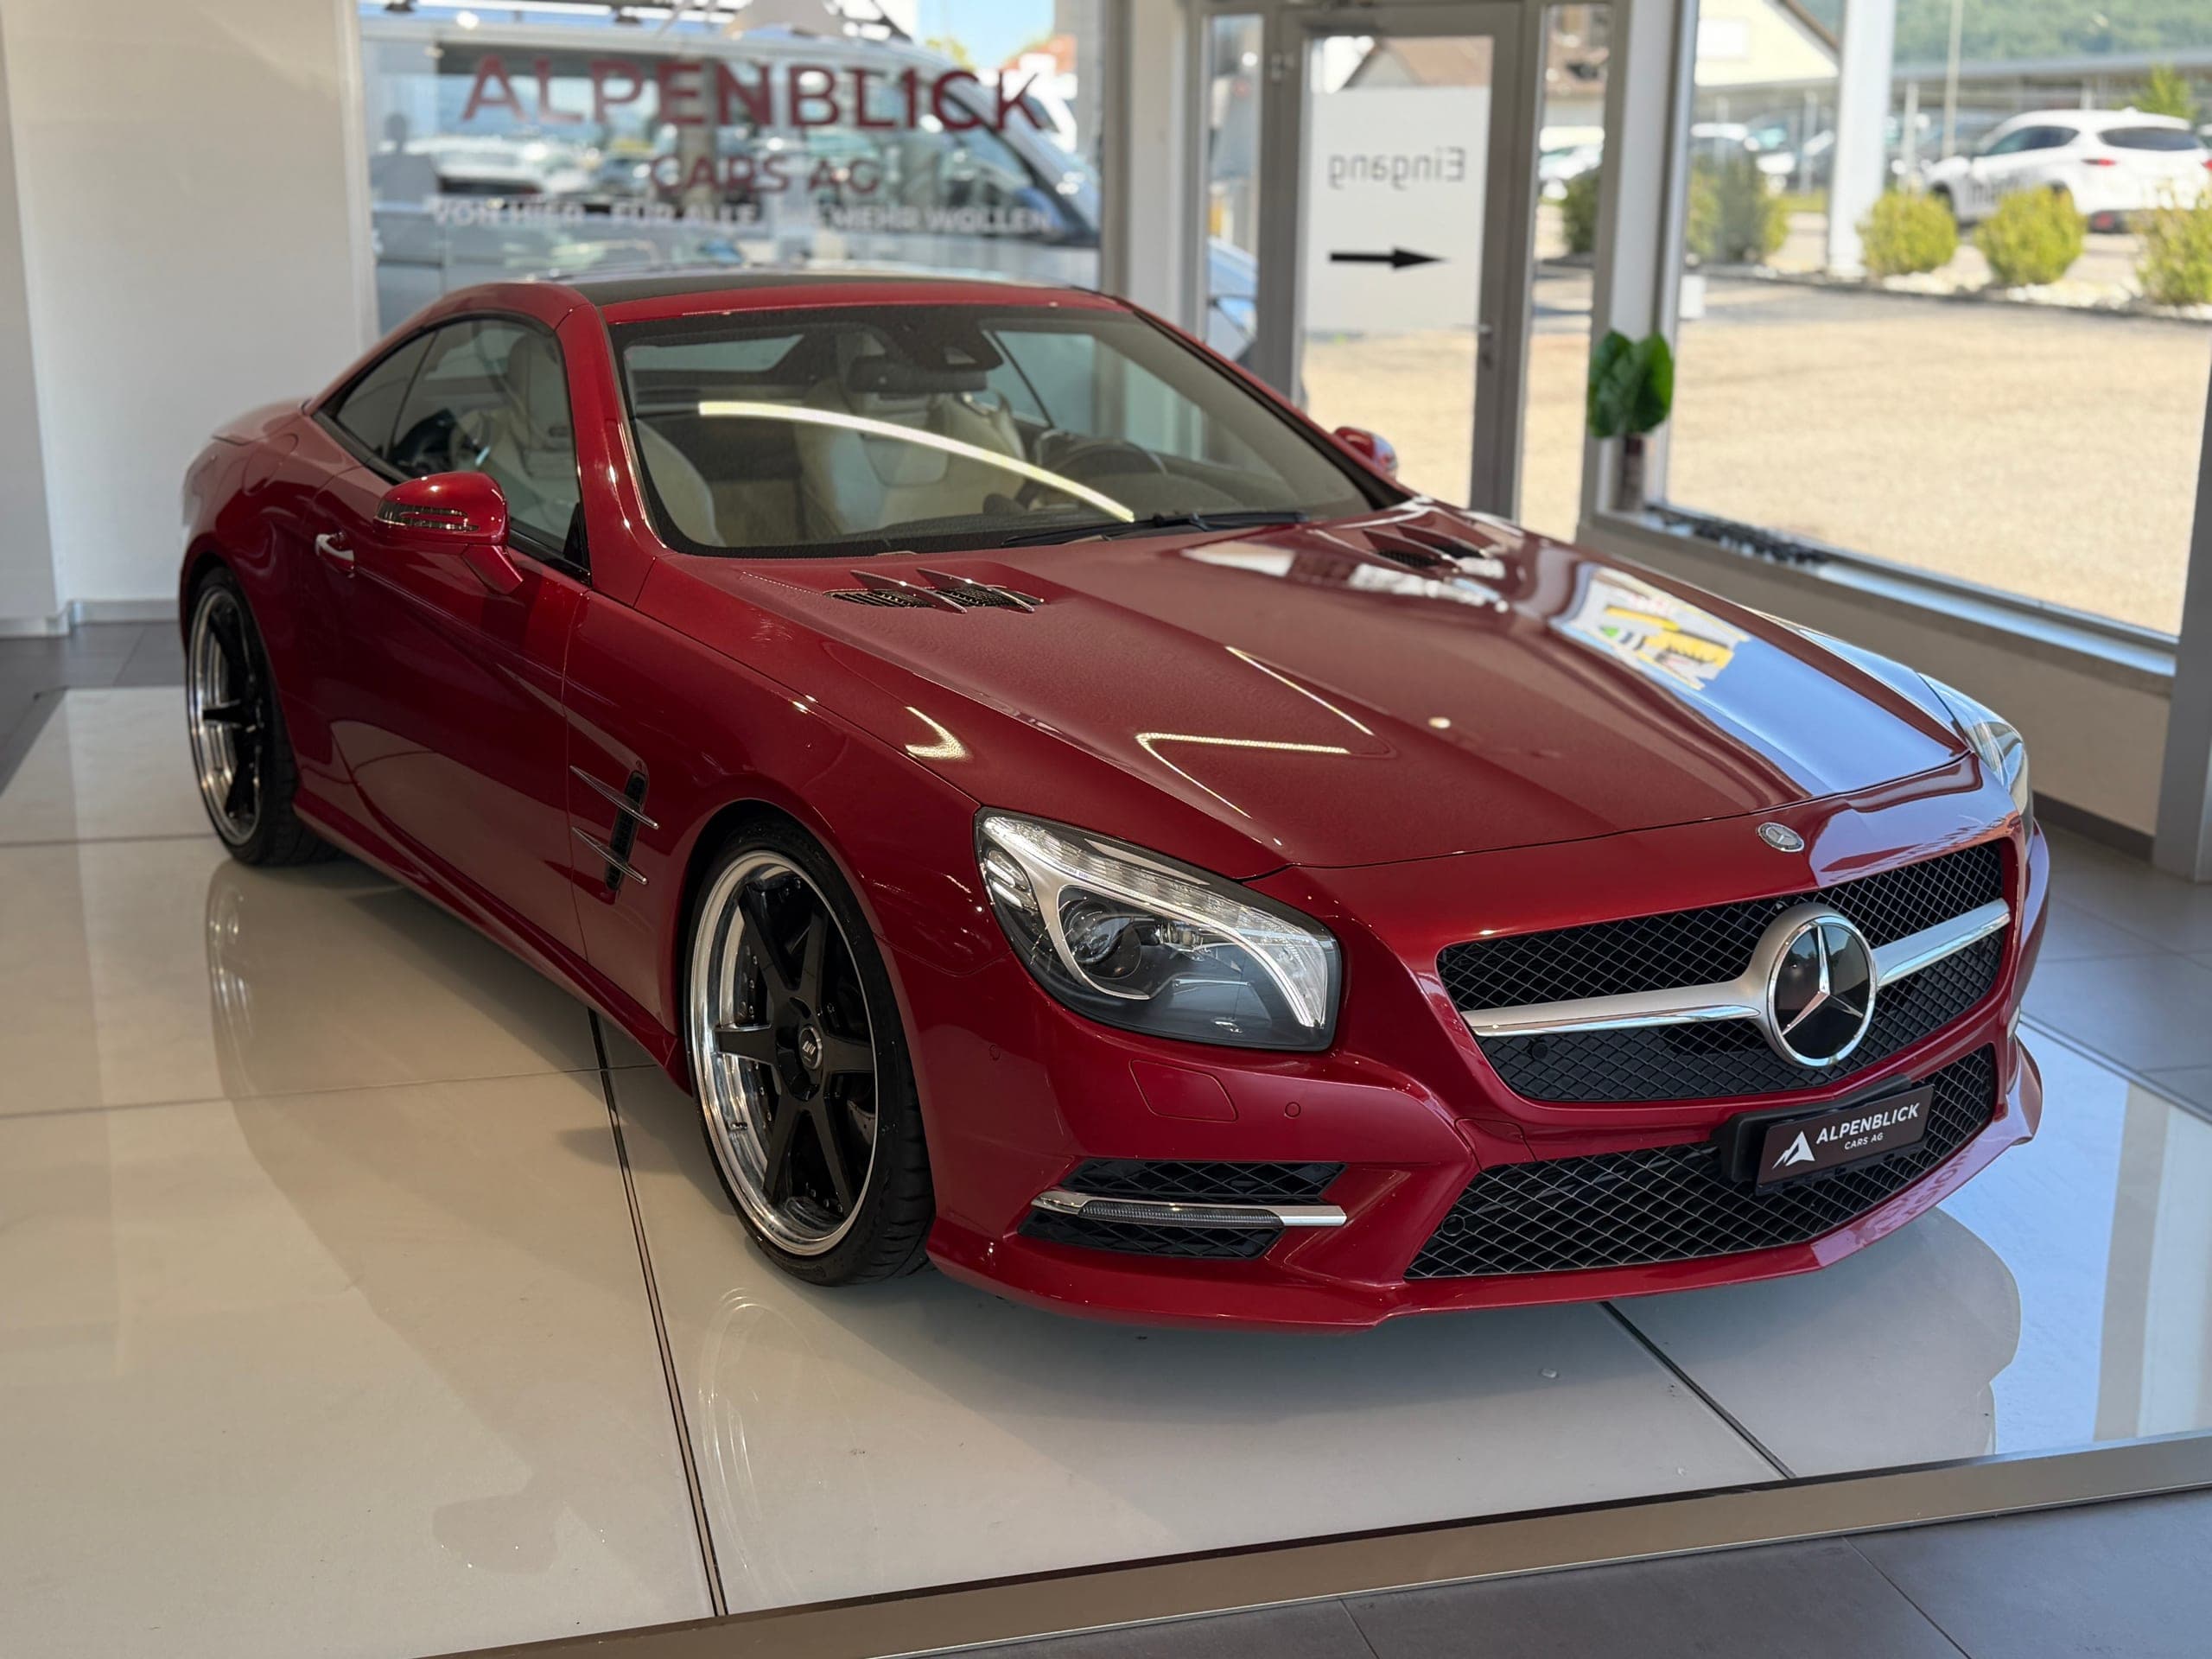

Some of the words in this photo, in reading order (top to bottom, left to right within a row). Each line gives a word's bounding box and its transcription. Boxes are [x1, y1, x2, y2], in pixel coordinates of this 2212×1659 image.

[461, 53, 1044, 132] ALPENBLICK
[652, 154, 791, 196] CARS
[1815, 1103, 1920, 1145] ALPENBLICK
[1844, 1136, 1868, 1150] CARS
[1870, 1132, 1885, 1143] AG
